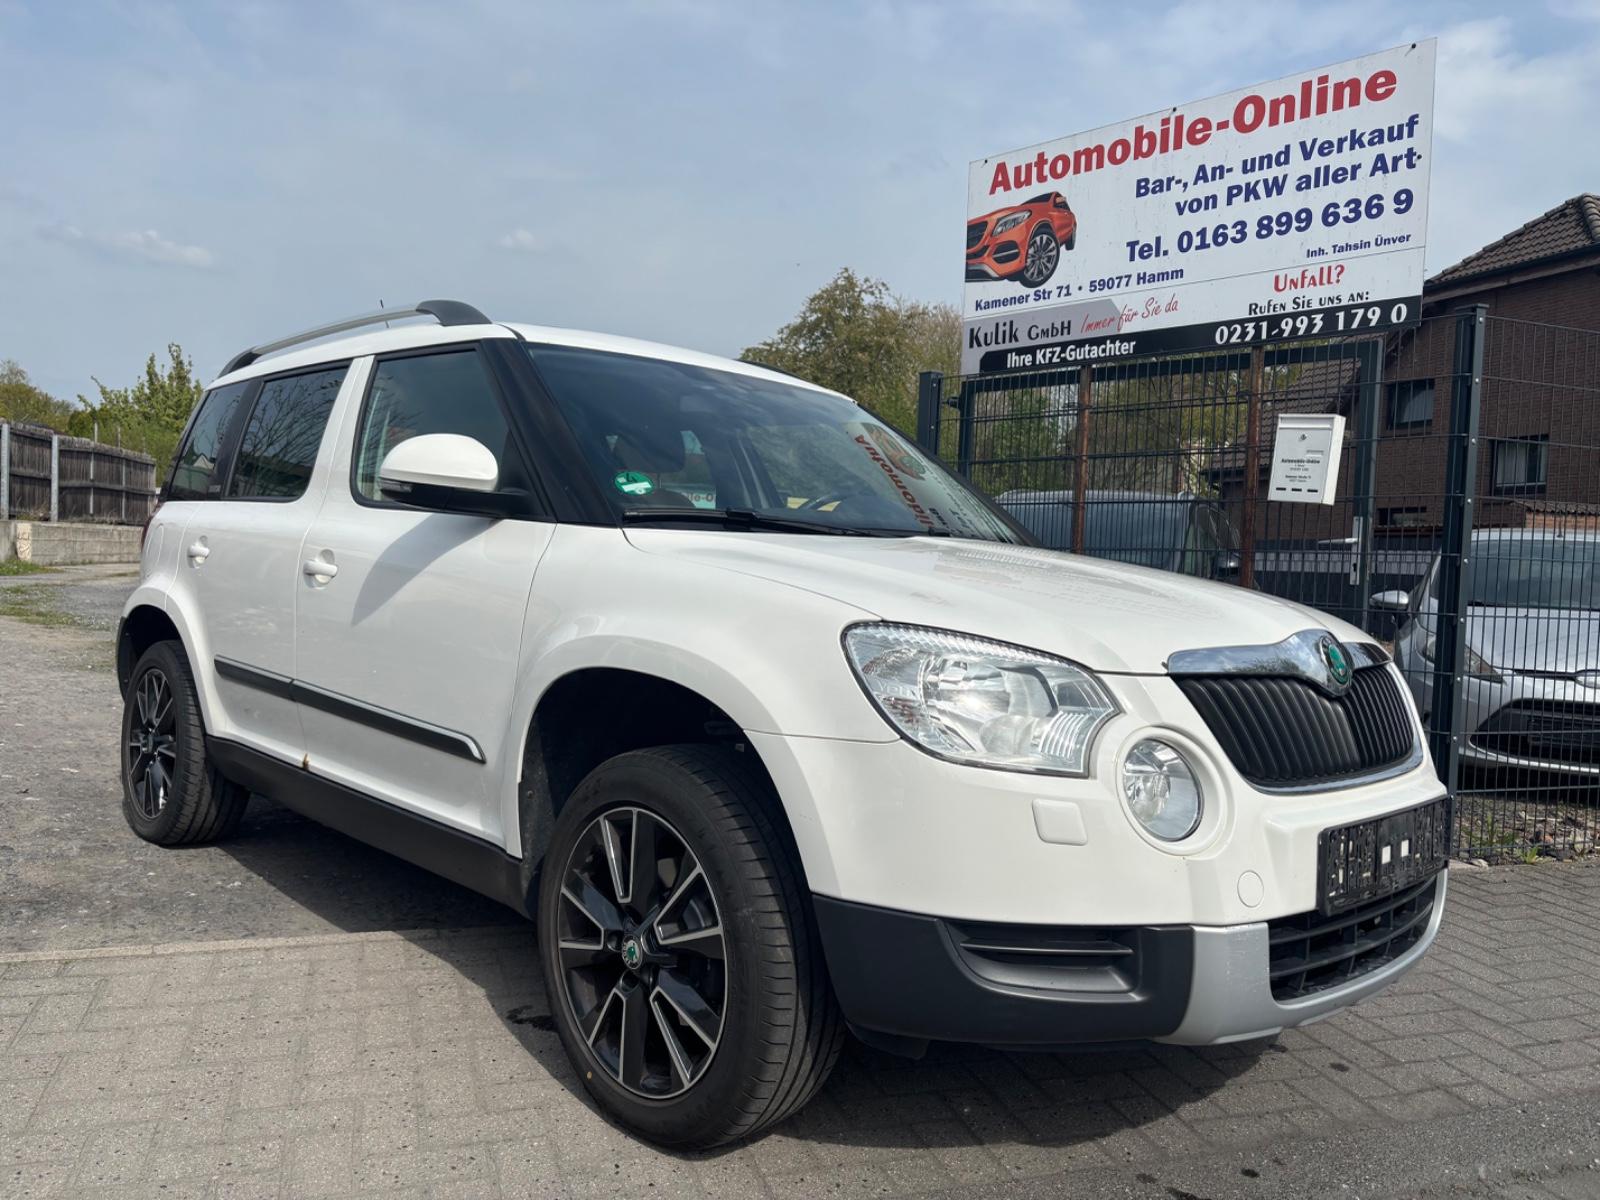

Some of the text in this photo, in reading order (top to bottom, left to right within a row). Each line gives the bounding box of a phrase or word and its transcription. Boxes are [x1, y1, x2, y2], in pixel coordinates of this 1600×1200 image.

[989, 69, 1397, 194] Automobile-Online
[1136, 114, 1419, 198] Bar-, An- und Verkauf
[1175, 193, 1218, 216] von
[1226, 174, 1288, 206] PKW
[1295, 162, 1362, 192] aller
[1126, 188, 1414, 262] Tel. 0163 899 636 9
[1306, 233, 1412, 259] Inh. Tahsin Ünver
[975, 268, 1184, 312] Kamener Str 71 59077 Hamm
[969, 319, 1072, 349] Kulik GmbH
[1080, 293, 1179, 334] Immer für Sie da
[1215, 303, 1408, 345] 0231-993 179 0
[1006, 339, 1136, 369] Ihre KFZ-Gutachter
